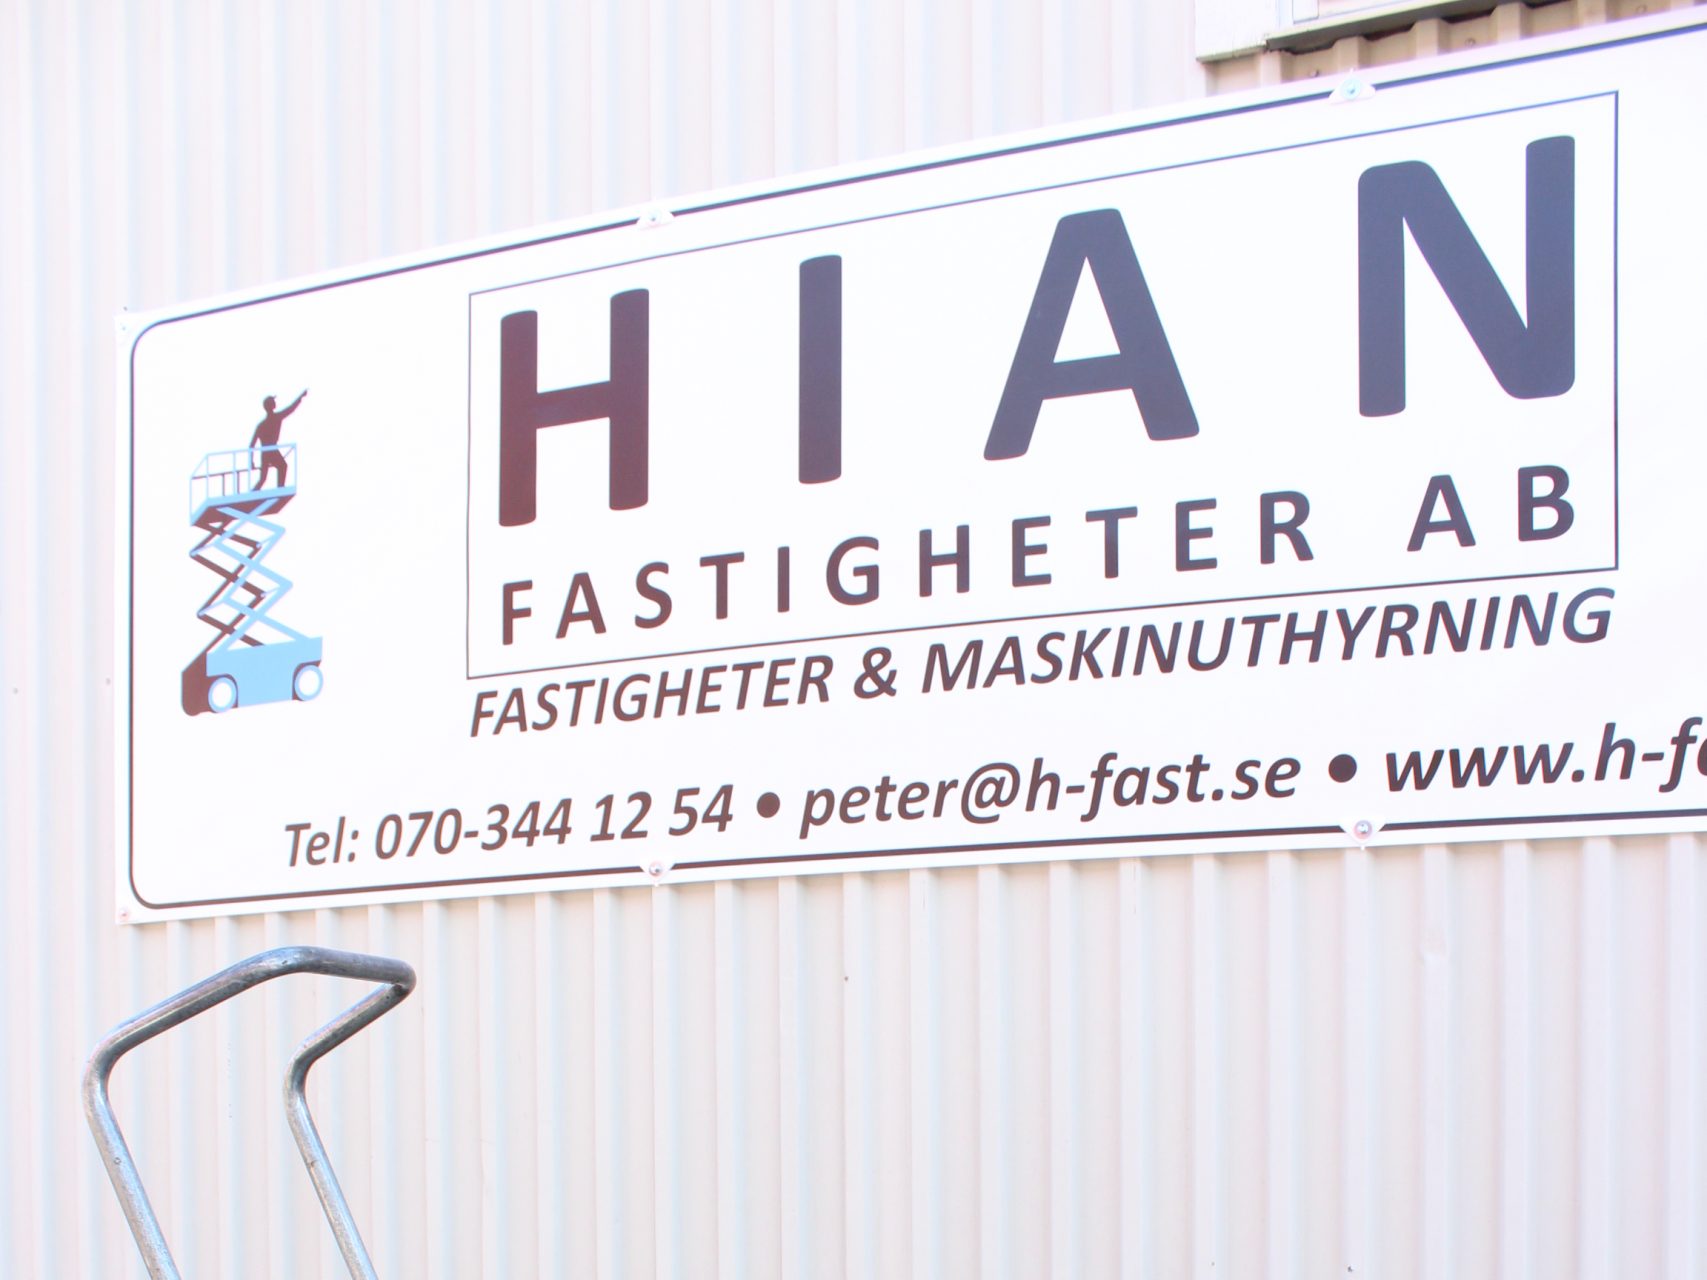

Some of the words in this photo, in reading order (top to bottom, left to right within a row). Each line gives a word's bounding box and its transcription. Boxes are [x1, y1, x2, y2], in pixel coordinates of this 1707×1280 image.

[499, 136, 1576, 528] HIAN
[502, 490, 1314, 646] FASTIGHETER
[1407, 464, 1575, 552] AB
[470, 653, 834, 738] FASTIGHETER
[853, 646, 899, 700] &
[921, 587, 1616, 694] MASKINUTHYRNING
[285, 816, 359, 867] Tel:
[375, 798, 572, 861] 070-344
[589, 791, 652, 842] 12
[668, 783, 734, 837] 54
[799, 751, 1302, 840] peter@h-fast.se
[1385, 716, 1707, 794] www.h-f
